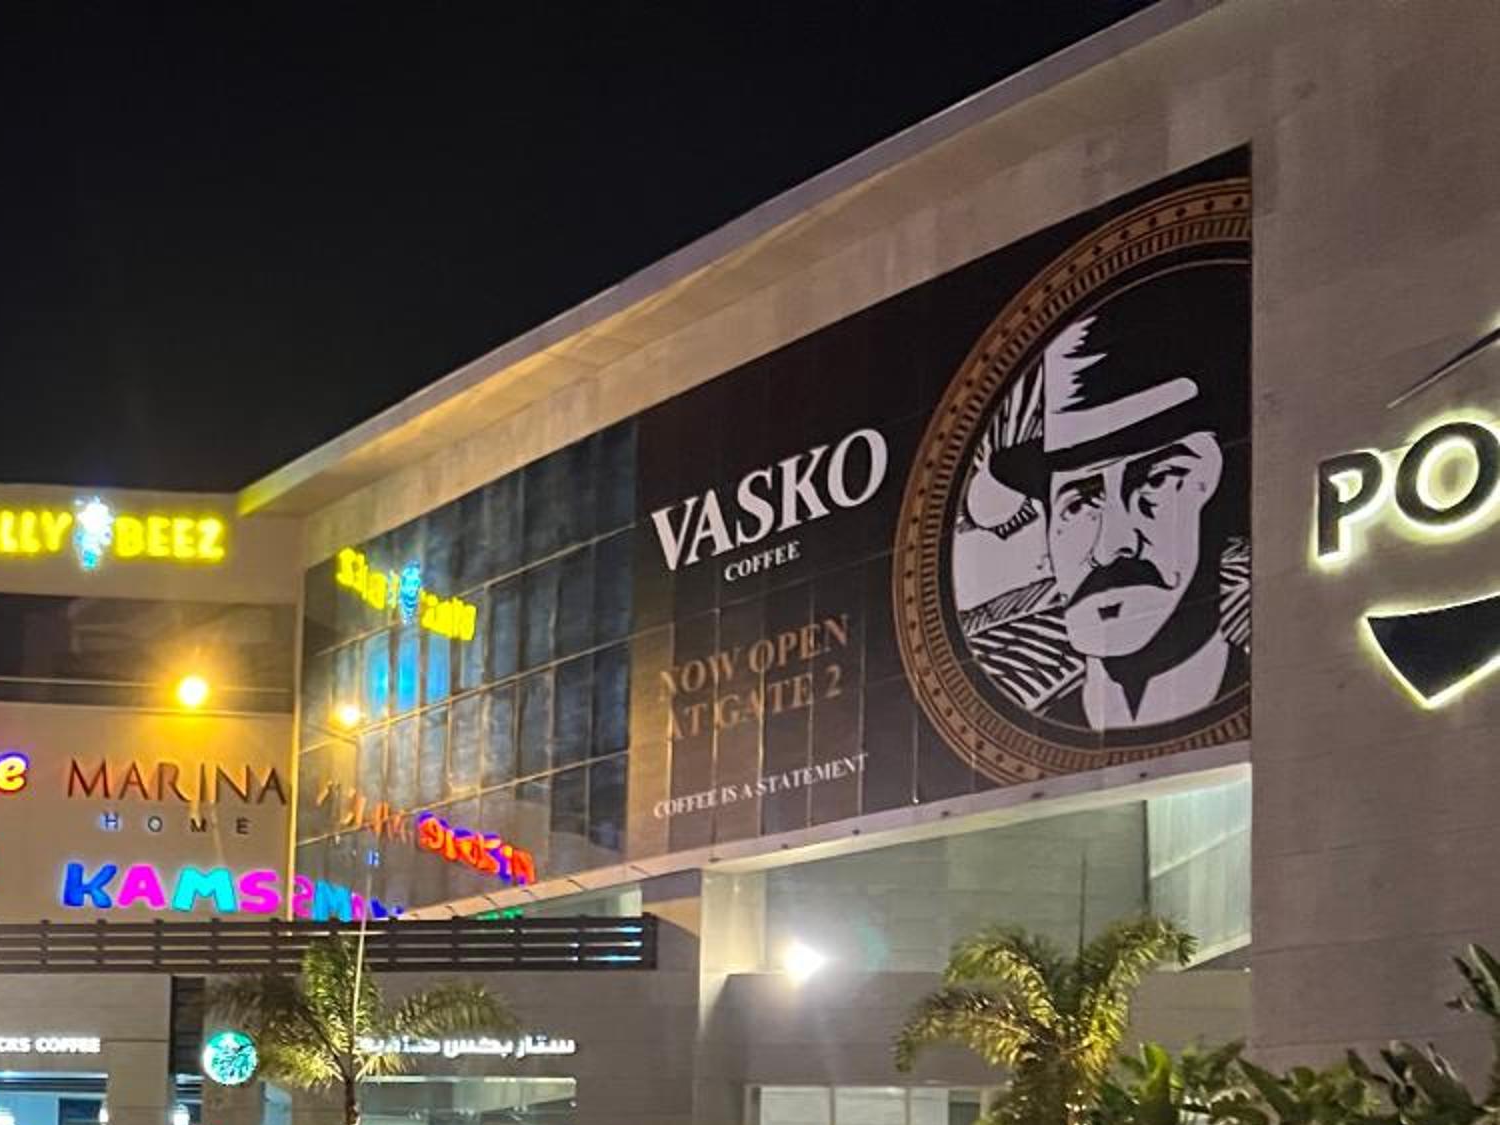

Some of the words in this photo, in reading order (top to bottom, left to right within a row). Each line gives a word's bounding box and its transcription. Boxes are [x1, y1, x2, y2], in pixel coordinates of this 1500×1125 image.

[651, 428, 888, 571] VASKO
[1315, 419, 1500, 560] PO
[115, 516, 225, 560] BEEZ
[723, 541, 800, 582] COFFEE
[660, 646, 742, 701] NOW
[749, 613, 849, 673] OPEN
[665, 702, 708, 740] AT
[714, 672, 814, 731] GATE
[825, 664, 842, 699] 2
[67, 759, 287, 805] MARINA
[653, 788, 717, 820] COFFEE
[721, 784, 738, 807] IS
[741, 781, 754, 800] A
[754, 753, 869, 797] STATEMENT
[103, 813, 250, 835] HOME
